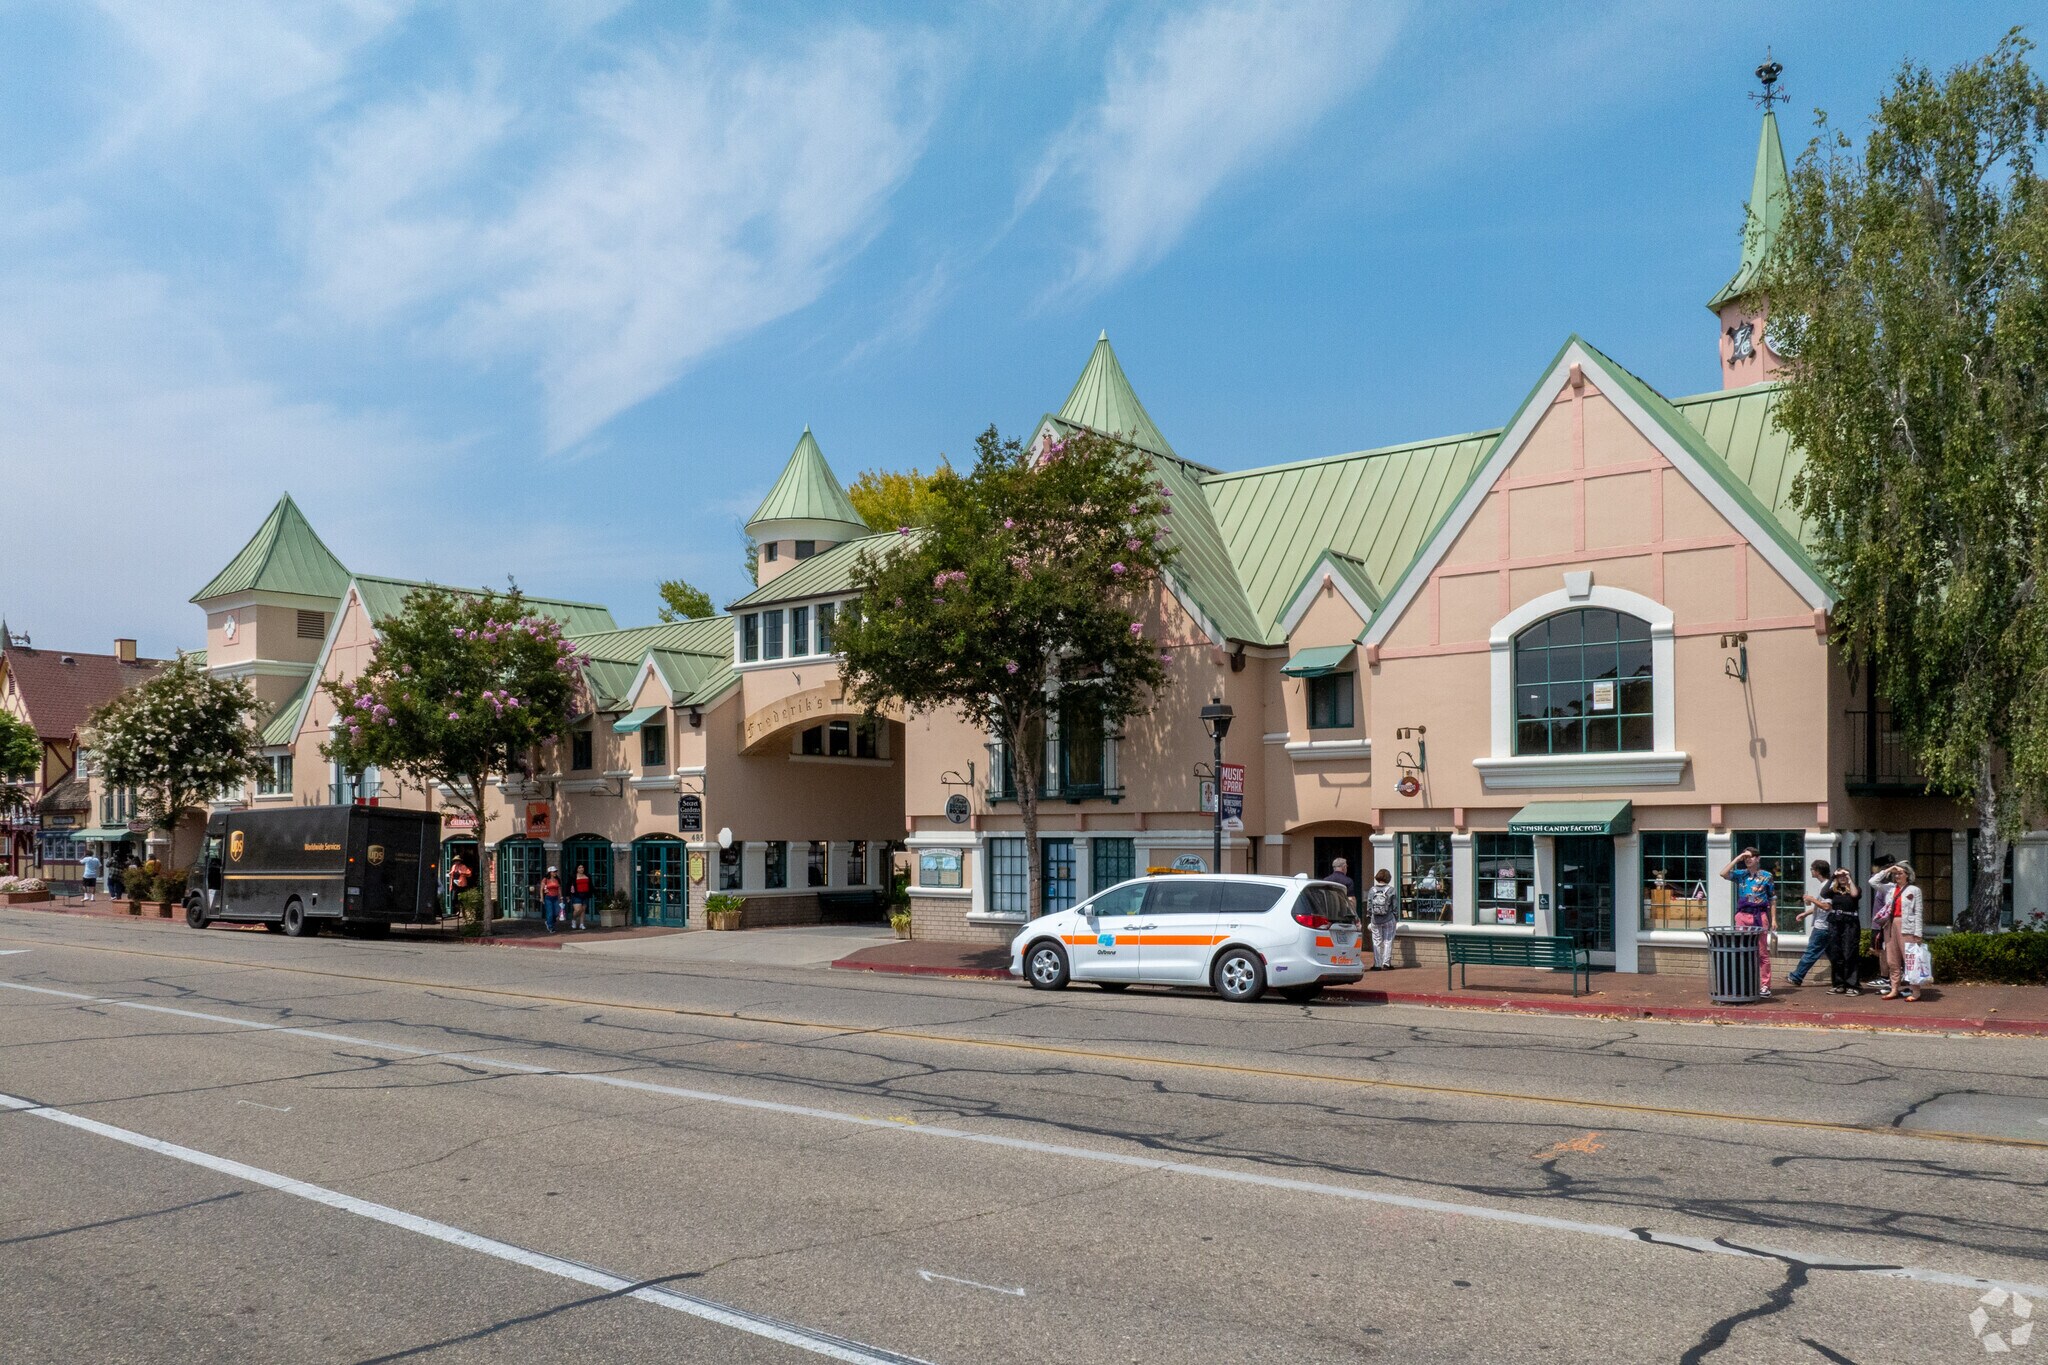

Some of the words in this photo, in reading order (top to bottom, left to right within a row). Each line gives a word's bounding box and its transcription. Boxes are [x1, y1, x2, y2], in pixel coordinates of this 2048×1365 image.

[746, 695, 824, 740] Frederik's
[1222, 766, 1244, 781] MUSIC
[1227, 780, 1243, 793] PARK
[691, 834, 704, 842] 485
[304, 843, 325, 851] Worldwide
[325, 842, 341, 850] Services
